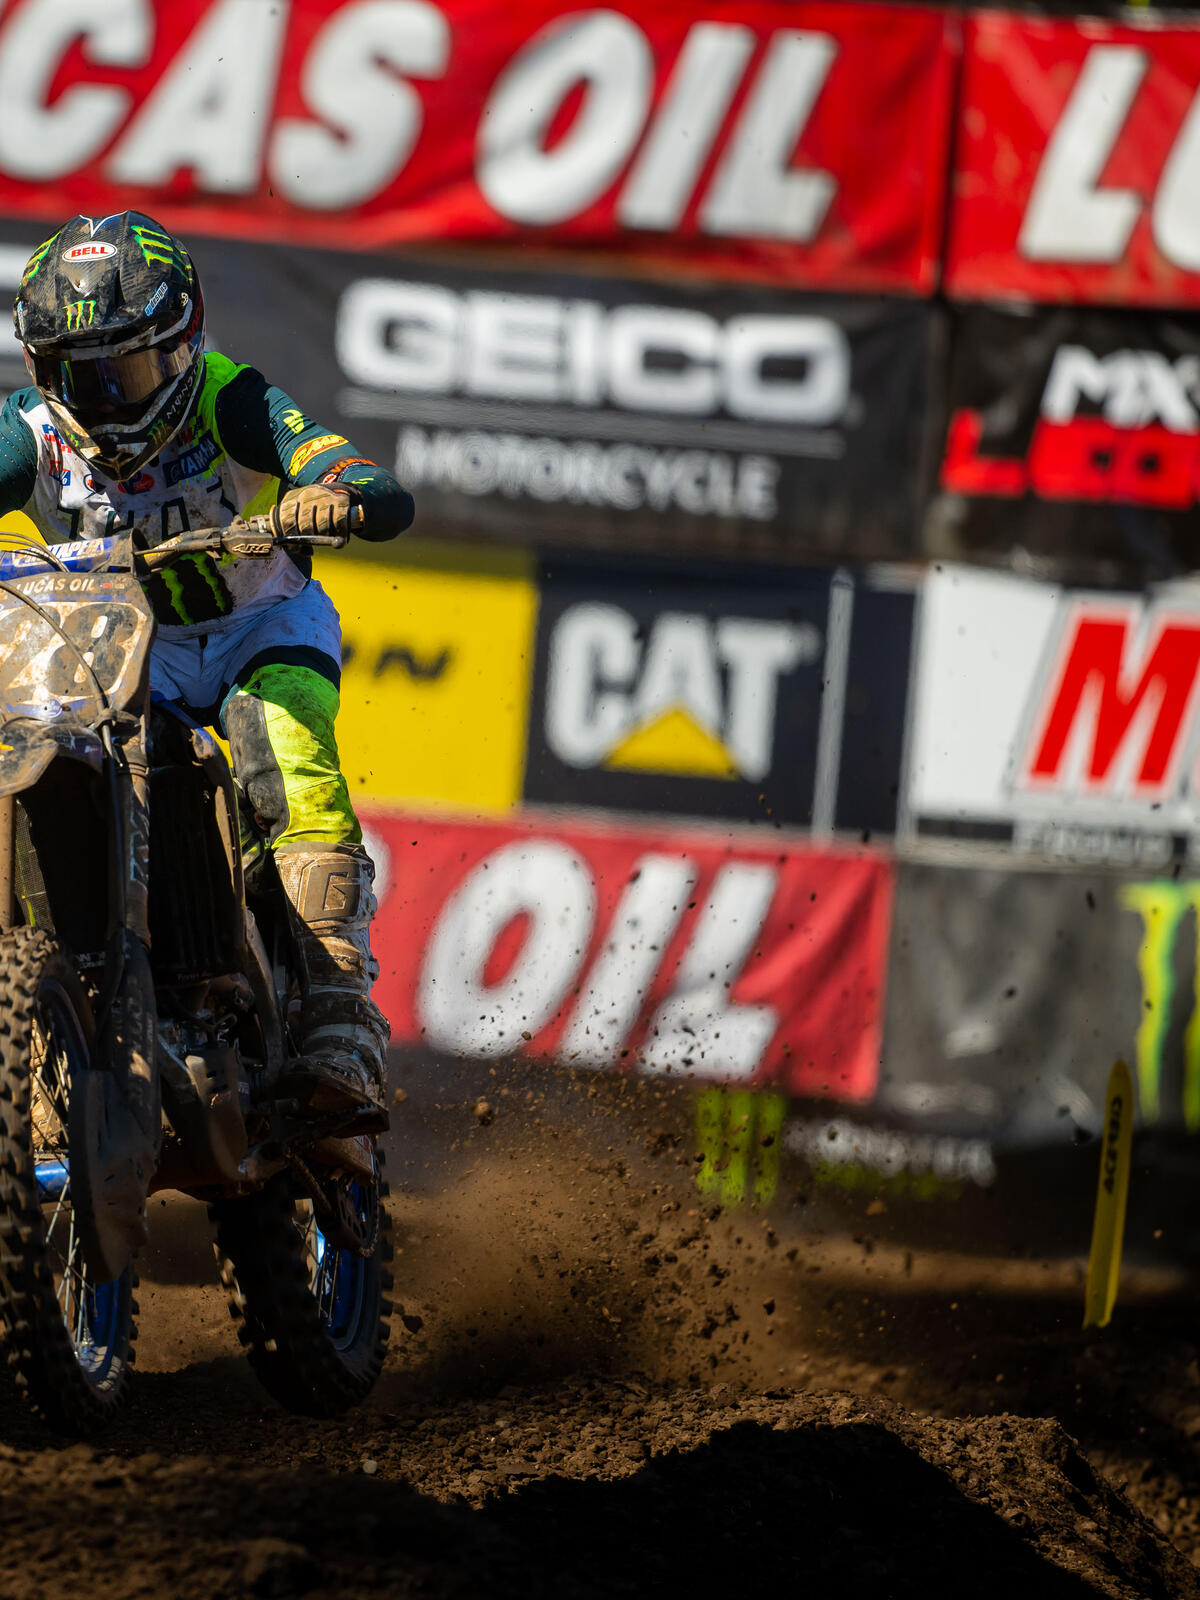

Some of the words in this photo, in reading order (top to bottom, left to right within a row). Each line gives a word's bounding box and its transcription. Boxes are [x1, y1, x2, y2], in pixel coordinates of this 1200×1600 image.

[476, 8, 839, 244] OIL
[1018, 42, 1200, 274] L
[71, 246, 109, 258] BELL
[335, 277, 853, 427] GEICO
[398, 427, 780, 521] MOTORCYCLE
[69, 578, 95, 592] OIL
[544, 601, 798, 783] CAT
[416, 836, 781, 1079] OIL
